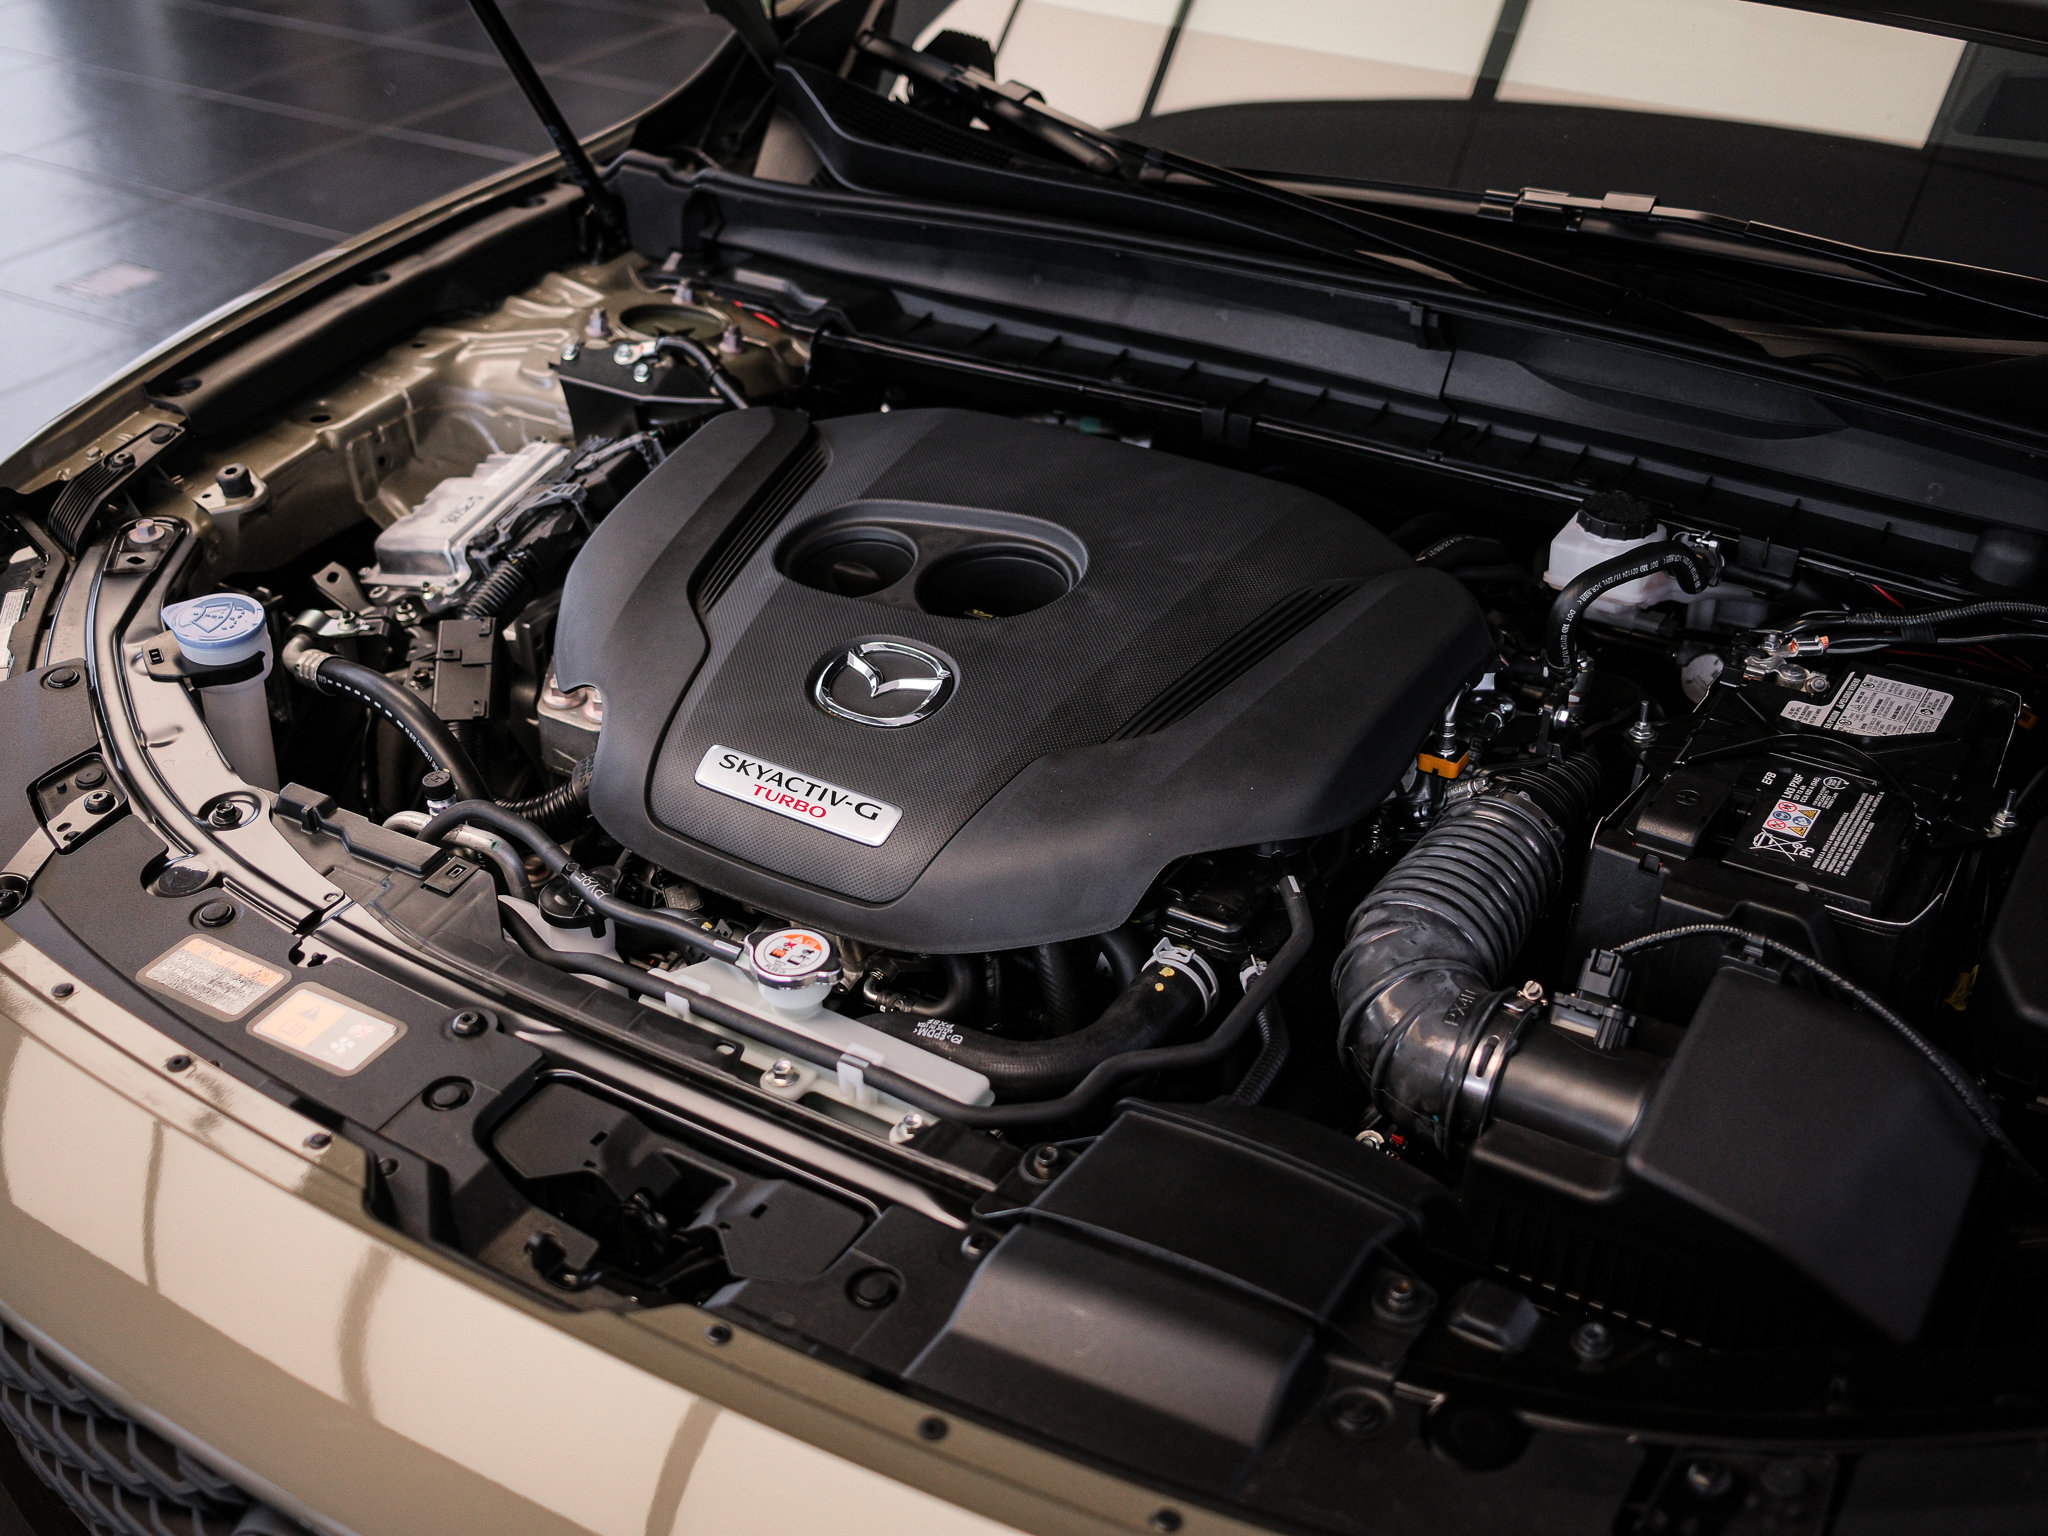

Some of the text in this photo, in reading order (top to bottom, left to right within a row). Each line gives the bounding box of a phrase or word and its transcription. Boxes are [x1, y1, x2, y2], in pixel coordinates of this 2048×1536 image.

[1565, 608, 1577, 622] DOT
[1761, 771, 1777, 785] EFB
[718, 753, 883, 821] SKYACTIV-G
[753, 783, 827, 819] TURBO
[1799, 847, 1815, 858] Pb
